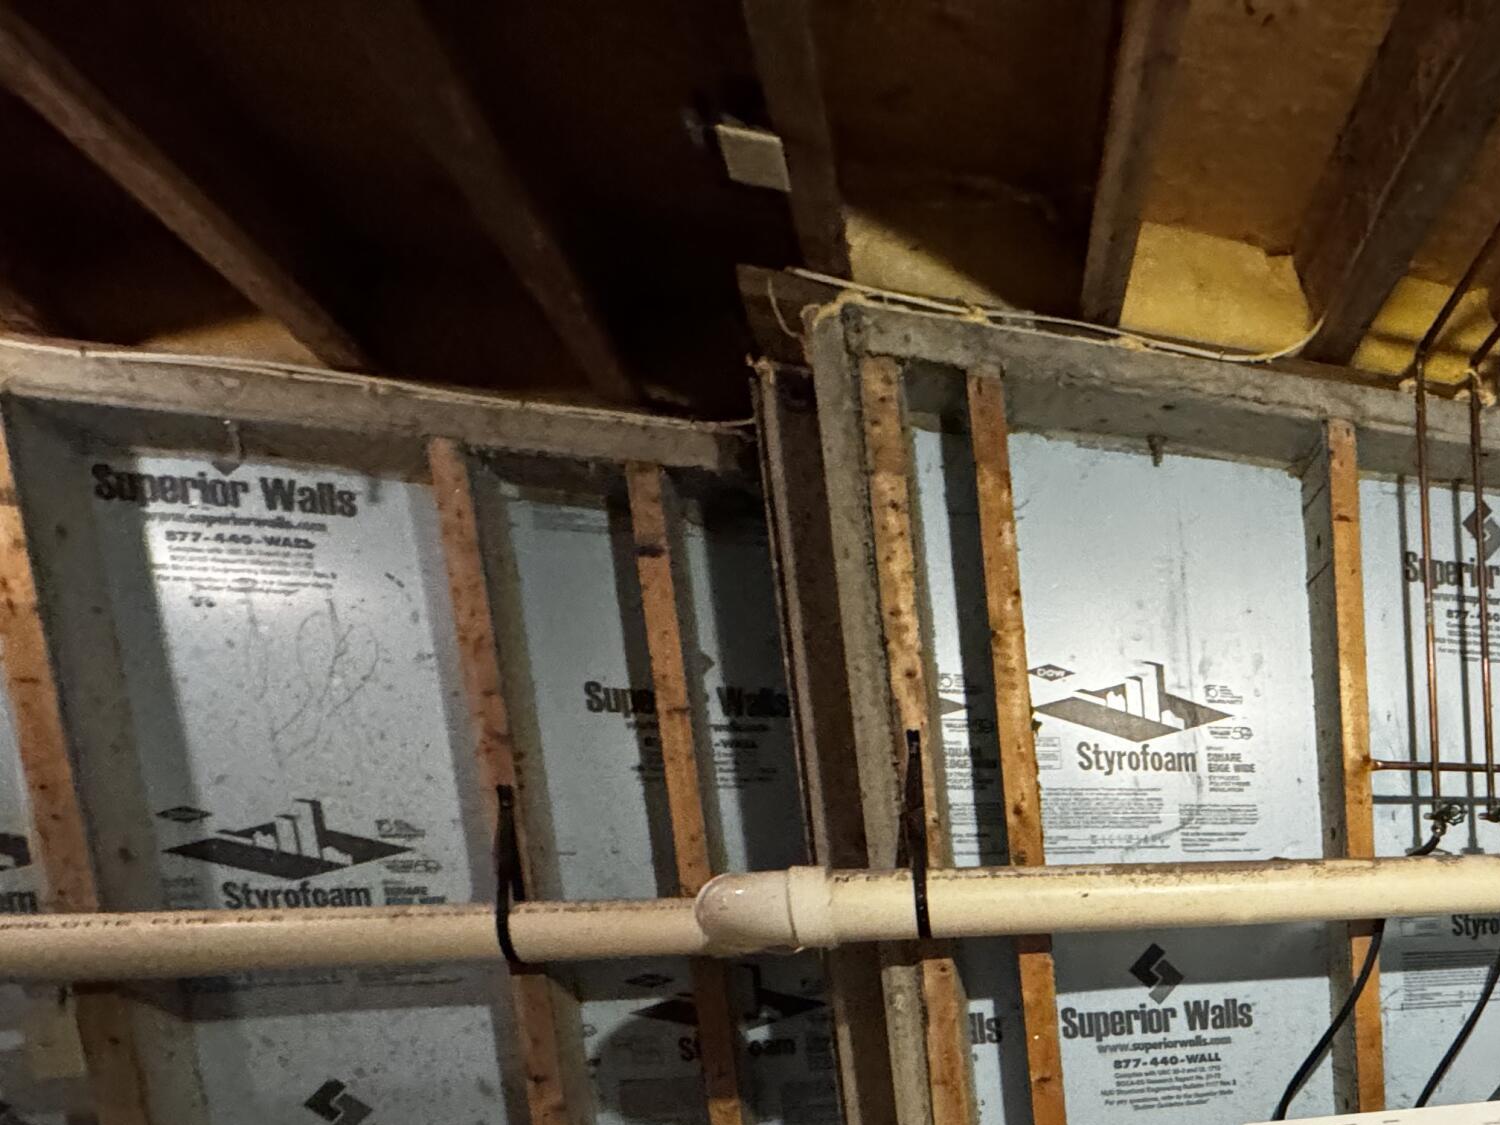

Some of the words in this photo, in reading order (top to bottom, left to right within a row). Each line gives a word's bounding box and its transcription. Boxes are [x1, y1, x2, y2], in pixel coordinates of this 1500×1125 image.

[92, 463, 249, 508] Superior
[259, 477, 358, 518] Walls
[1076, 741, 1197, 776] Styrofoam
[222, 880, 371, 908] Styrofoam
[1061, 1003, 1177, 1042] Superior
[1184, 998, 1253, 1031] Walls
[1113, 1052, 1221, 1069] 877-440-WALL
